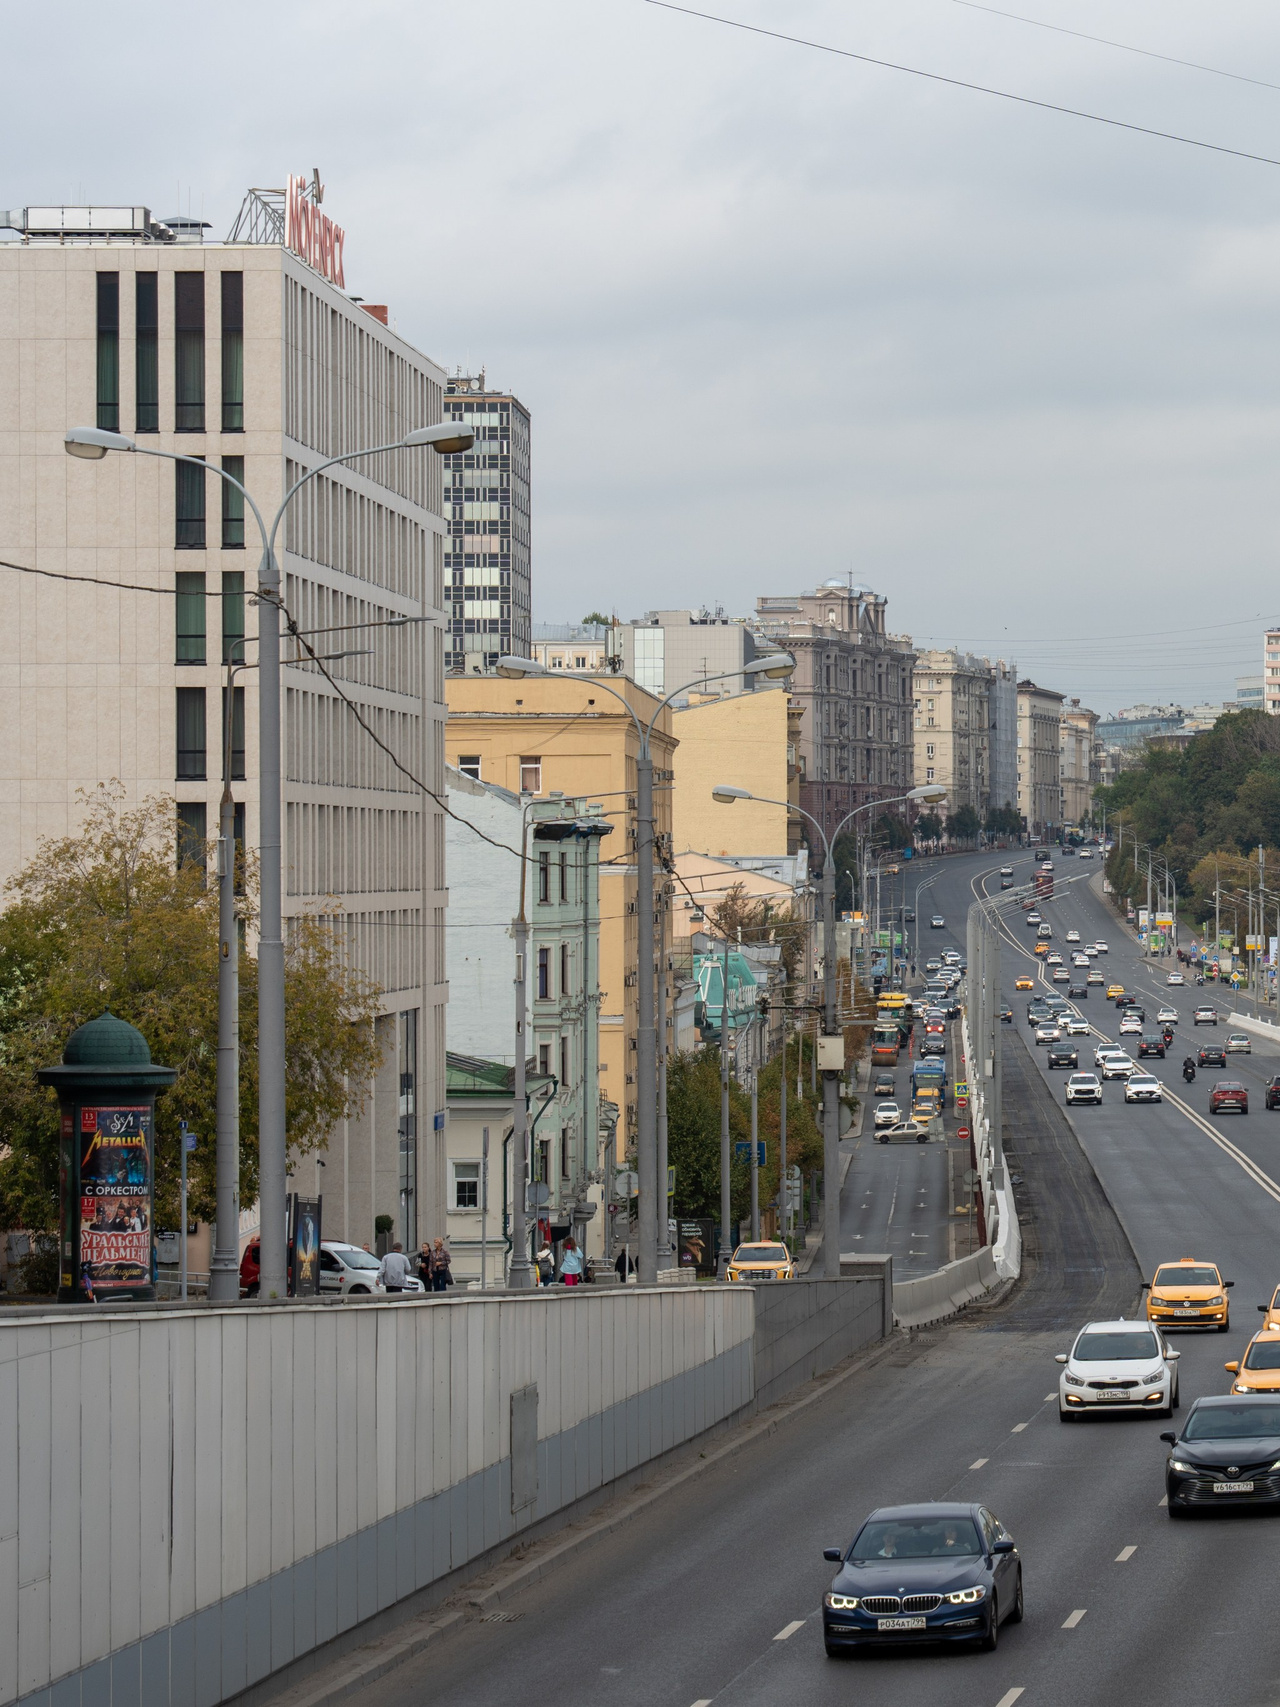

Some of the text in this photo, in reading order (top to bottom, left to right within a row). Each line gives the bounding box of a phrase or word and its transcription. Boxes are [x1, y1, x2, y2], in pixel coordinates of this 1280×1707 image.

[85, 1186, 149, 1196] С ОРКЕСТРОМ
[82, 1231, 150, 1248] УРАЛЬСКИЕ
[82, 1248, 150, 1266] ПЕЛЬМЕНИ
[880, 1619, 911, 1628] Р034АТ
